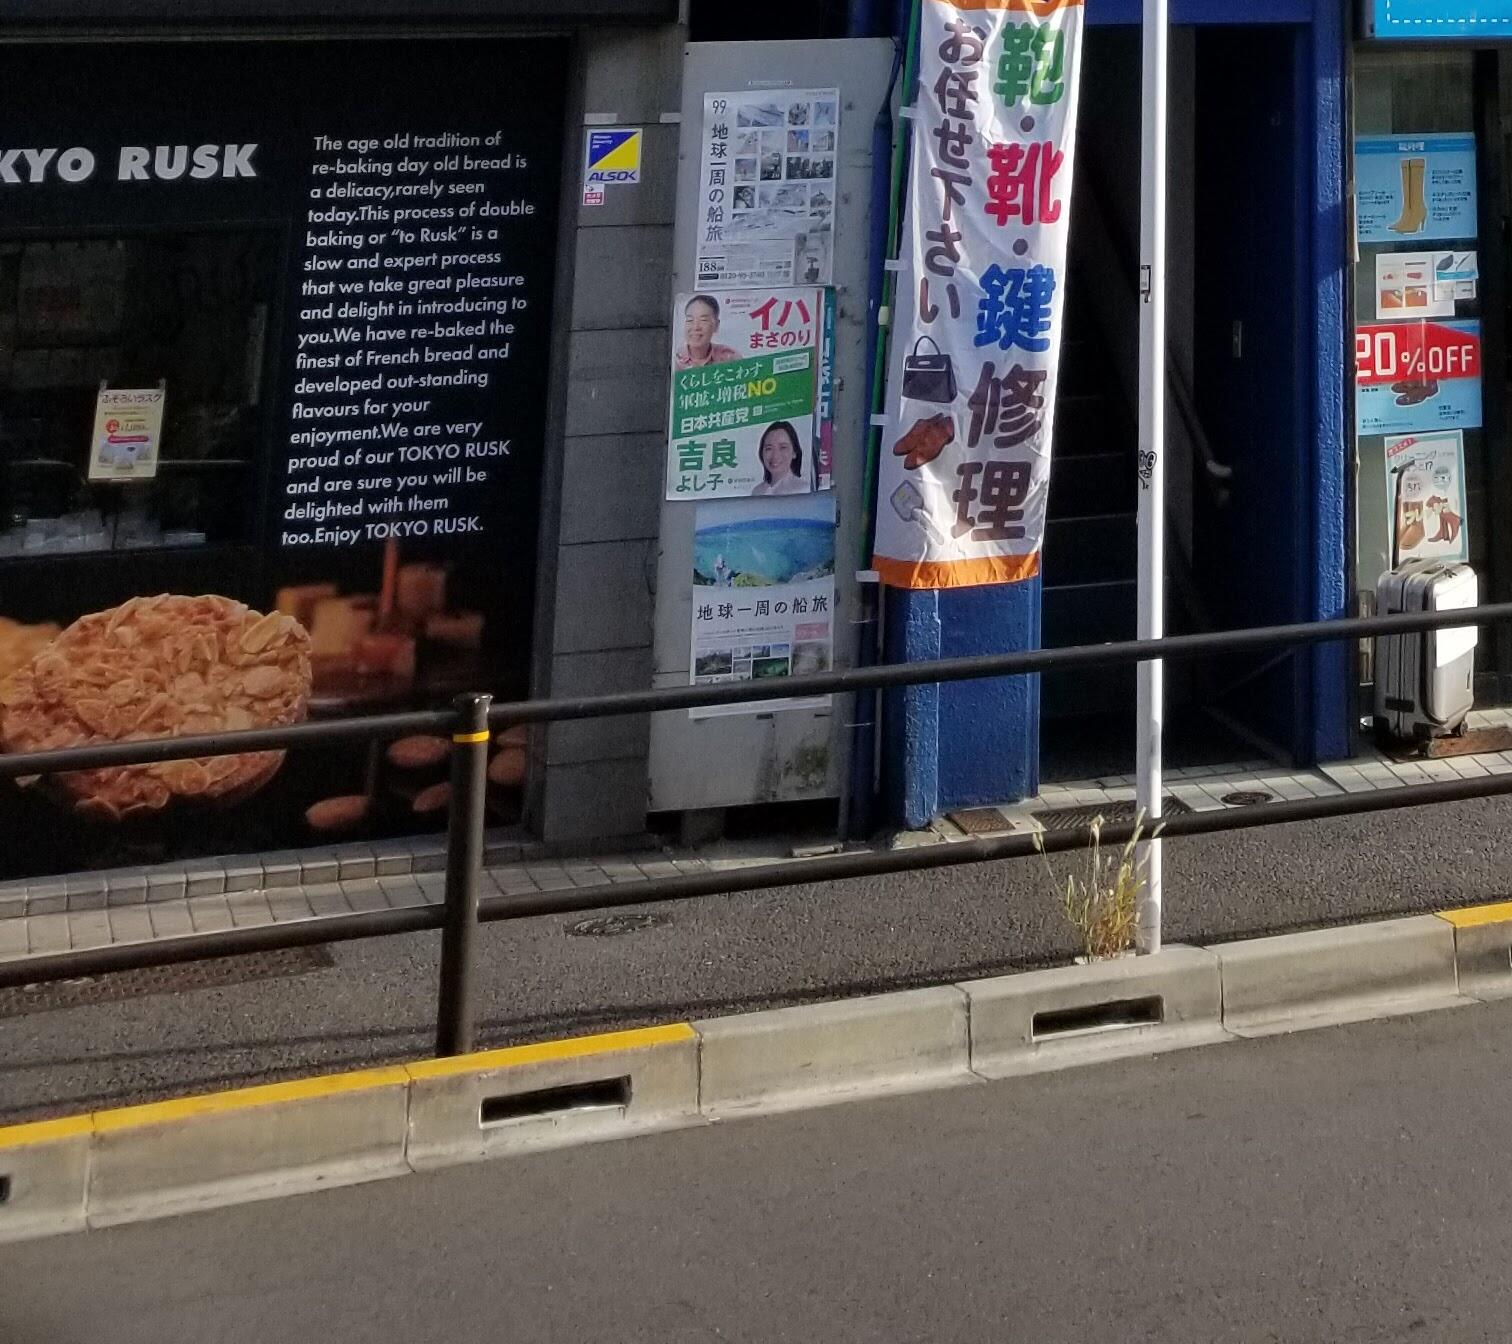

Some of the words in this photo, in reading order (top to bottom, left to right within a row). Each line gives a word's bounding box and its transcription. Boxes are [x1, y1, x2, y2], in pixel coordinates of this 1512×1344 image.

[712, 99, 727, 115] 99
[314, 135, 342, 151] The
[347, 139, 378, 153] age
[384, 134, 408, 149] old
[413, 133, 480, 148] tradition
[484, 131, 502, 146] of
[118, 144, 258, 180] RUSK
[312, 159, 392, 176] re-baking
[397, 157, 428, 176] day
[433, 156, 458, 171] old
[463, 154, 511, 170] bread
[515, 154, 527, 169] is
[919, 19, 984, 326] お任せ下さい
[588, 171, 636, 182] ALSOK
[705, 123, 729, 242] 地球一周の船旅
[310, 187, 321, 199] a
[448, 183, 485, 195] seen
[394, 205, 454, 223] process
[459, 202, 475, 218] of
[479, 200, 535, 217] double
[306, 231, 363, 249] baking
[368, 233, 386, 245] or
[471, 226, 483, 240] is
[487, 228, 498, 240] a
[304, 255, 342, 271] slow
[347, 253, 379, 269] and
[383, 253, 437, 271] expert
[441, 252, 501, 269] process
[302, 280, 335, 296] that
[339, 282, 364, 294] we
[368, 276, 403, 293] take
[408, 276, 451, 294] great
[455, 273, 524, 292] pleasure
[300, 303, 333, 320] and
[337, 300, 394, 321] delight
[398, 301, 412, 315] in
[417, 297, 507, 315] introducing
[512, 297, 527, 310] to
[750, 296, 811, 331] イハ
[366, 325, 406, 341] have
[410, 320, 485, 339] re-baked
[490, 319, 515, 335] the
[750, 330, 811, 349] まさのり
[296, 352, 340, 369] finest
[345, 350, 362, 366] of
[366, 347, 419, 366] French
[425, 345, 473, 363] bread
[478, 343, 509, 360] and
[294, 374, 382, 395] developed
[387, 369, 489, 389] out-standing
[680, 362, 763, 391] くらしをこわす
[292, 401, 359, 419] flavours
[364, 398, 388, 415] for
[392, 400, 431, 418] your
[680, 406, 749, 434] 日本共産党
[413, 424, 441, 437] are
[445, 421, 483, 438] very
[287, 450, 339, 474] proud
[344, 448, 362, 466] of
[365, 450, 394, 464] our
[398, 443, 460, 463] TOKYO
[465, 440, 512, 458] RUSK
[676, 438, 739, 473] 吉良
[286, 476, 319, 495] and
[324, 478, 353, 492] are
[357, 476, 392, 490] sure
[397, 474, 428, 491] you
[433, 467, 462, 485] will
[466, 466, 487, 482] be
[675, 473, 724, 493] よし子
[284, 498, 363, 522] delighted
[368, 495, 403, 514] with
[407, 494, 449, 512] them
[365, 519, 428, 540] TOKYO
[697, 595, 828, 621] 地球一周の船旅
